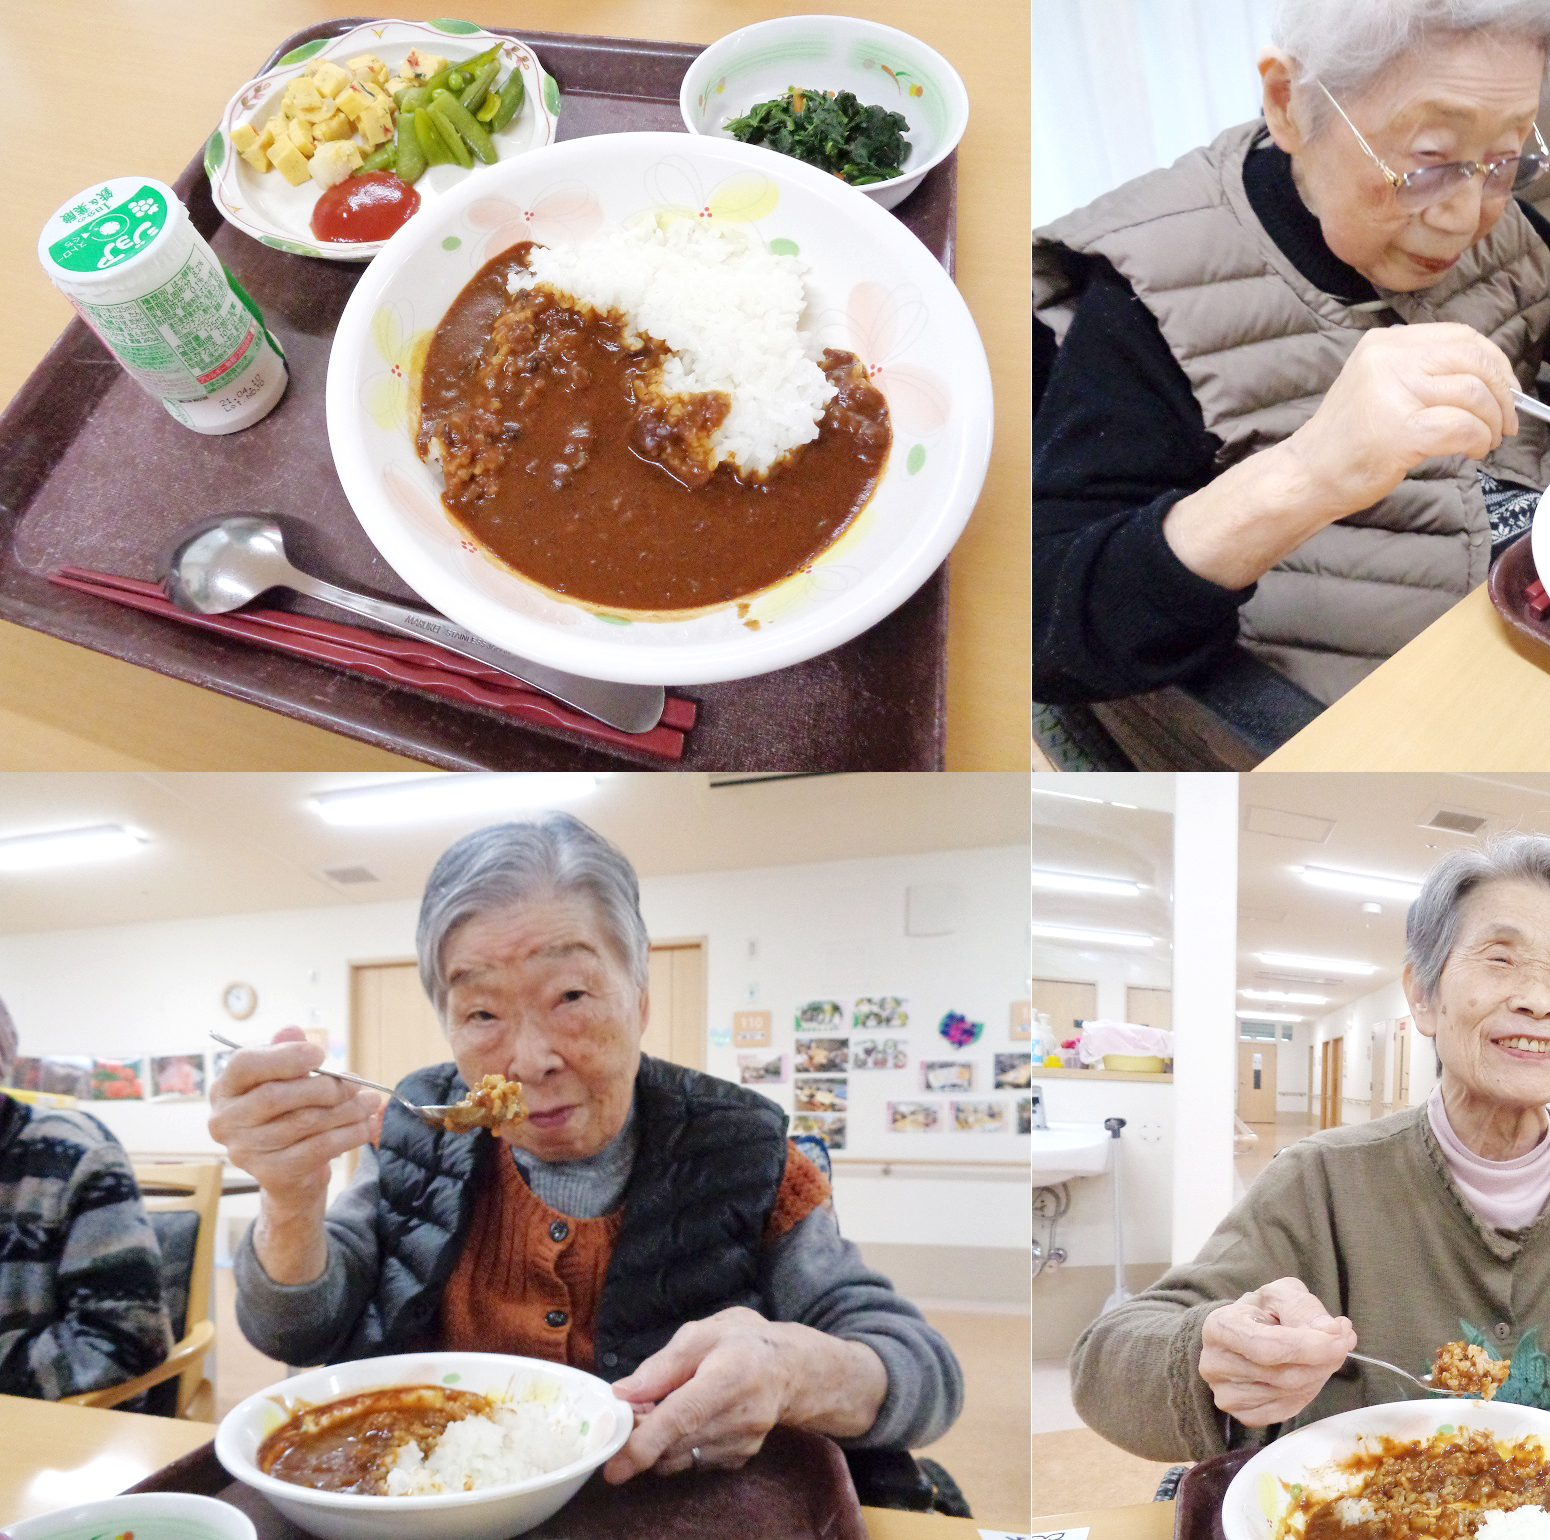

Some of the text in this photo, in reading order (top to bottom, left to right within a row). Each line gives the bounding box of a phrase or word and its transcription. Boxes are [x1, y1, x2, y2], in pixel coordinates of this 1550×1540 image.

[57, 240, 87, 263] ストロー
[97, 220, 159, 270] ジョア
